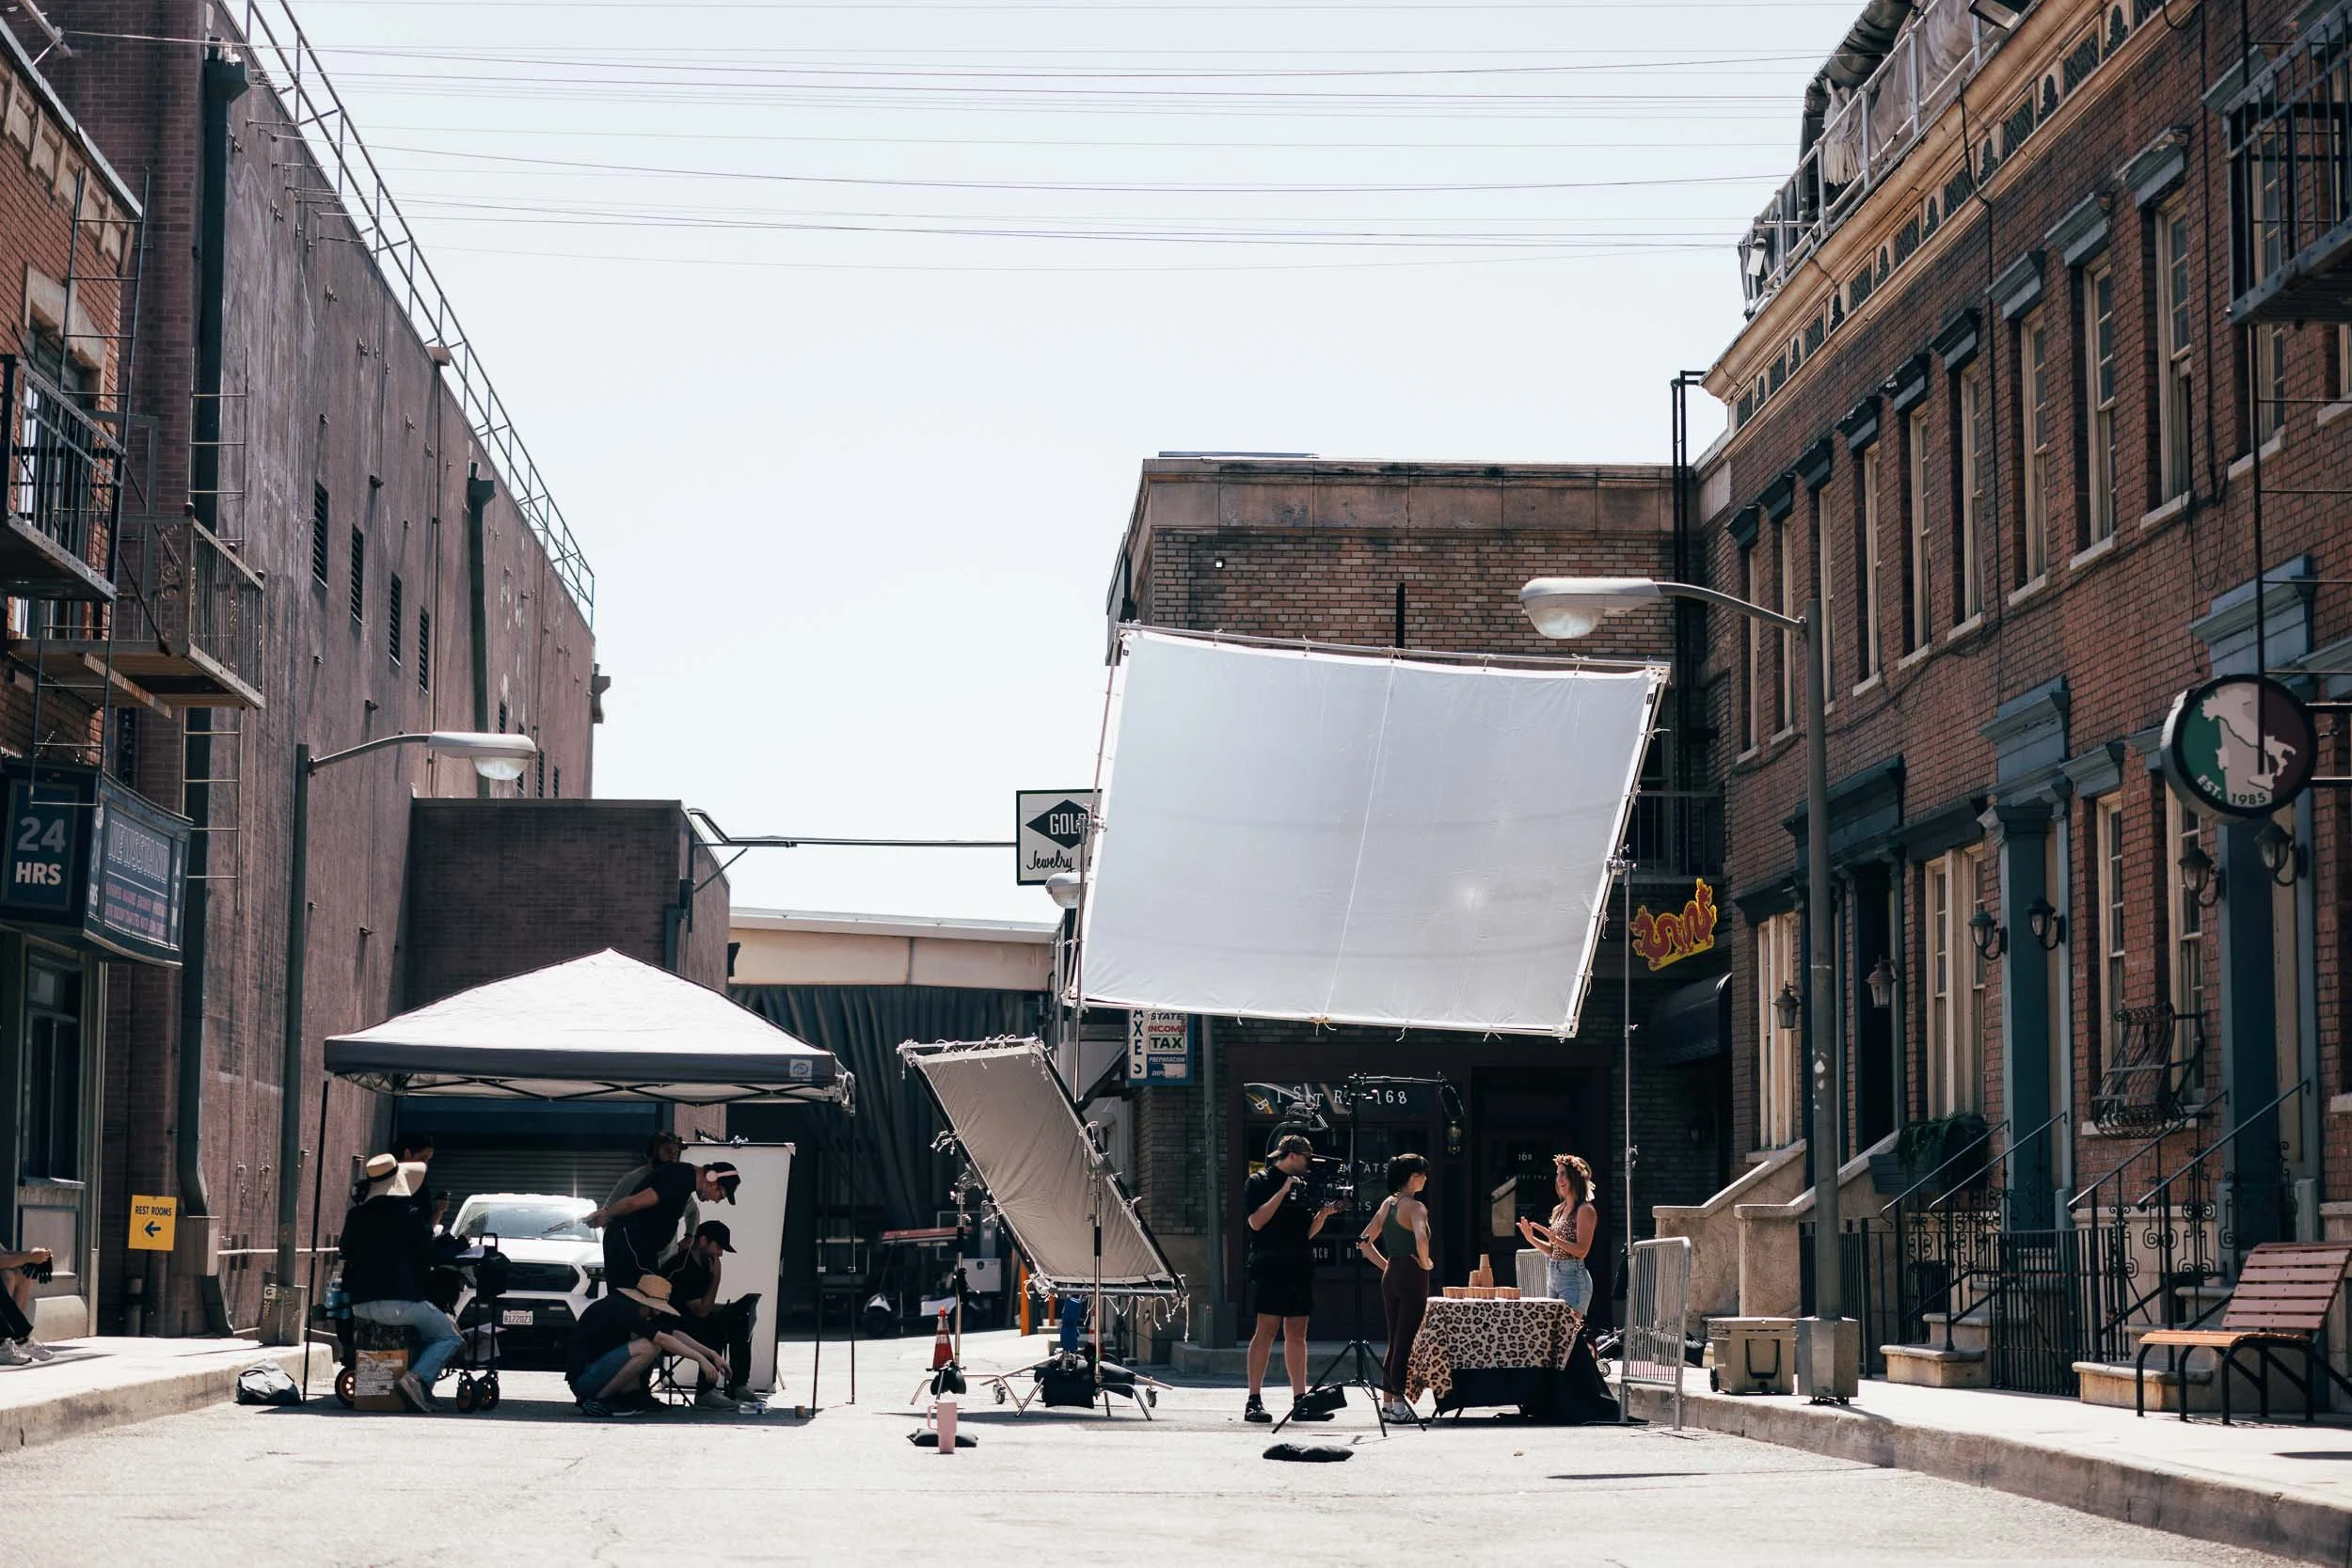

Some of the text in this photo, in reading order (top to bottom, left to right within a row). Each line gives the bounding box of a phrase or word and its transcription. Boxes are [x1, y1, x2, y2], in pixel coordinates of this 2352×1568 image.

[2196, 774, 2222, 800] EST.
[2231, 793, 2266, 806] 1985
[16, 816, 66, 853] 24
[1026, 849, 1076, 873] Jewelry
[15, 862, 62, 886] HRS
[1150, 1012, 1184, 1021] STATE
[1150, 1037, 1183, 1049] TAX
[1255, 1085, 1347, 1111] BISTR
[1343, 1163, 1390, 1174] MATS
[135, 1205, 172, 1216] REST ROOMS
